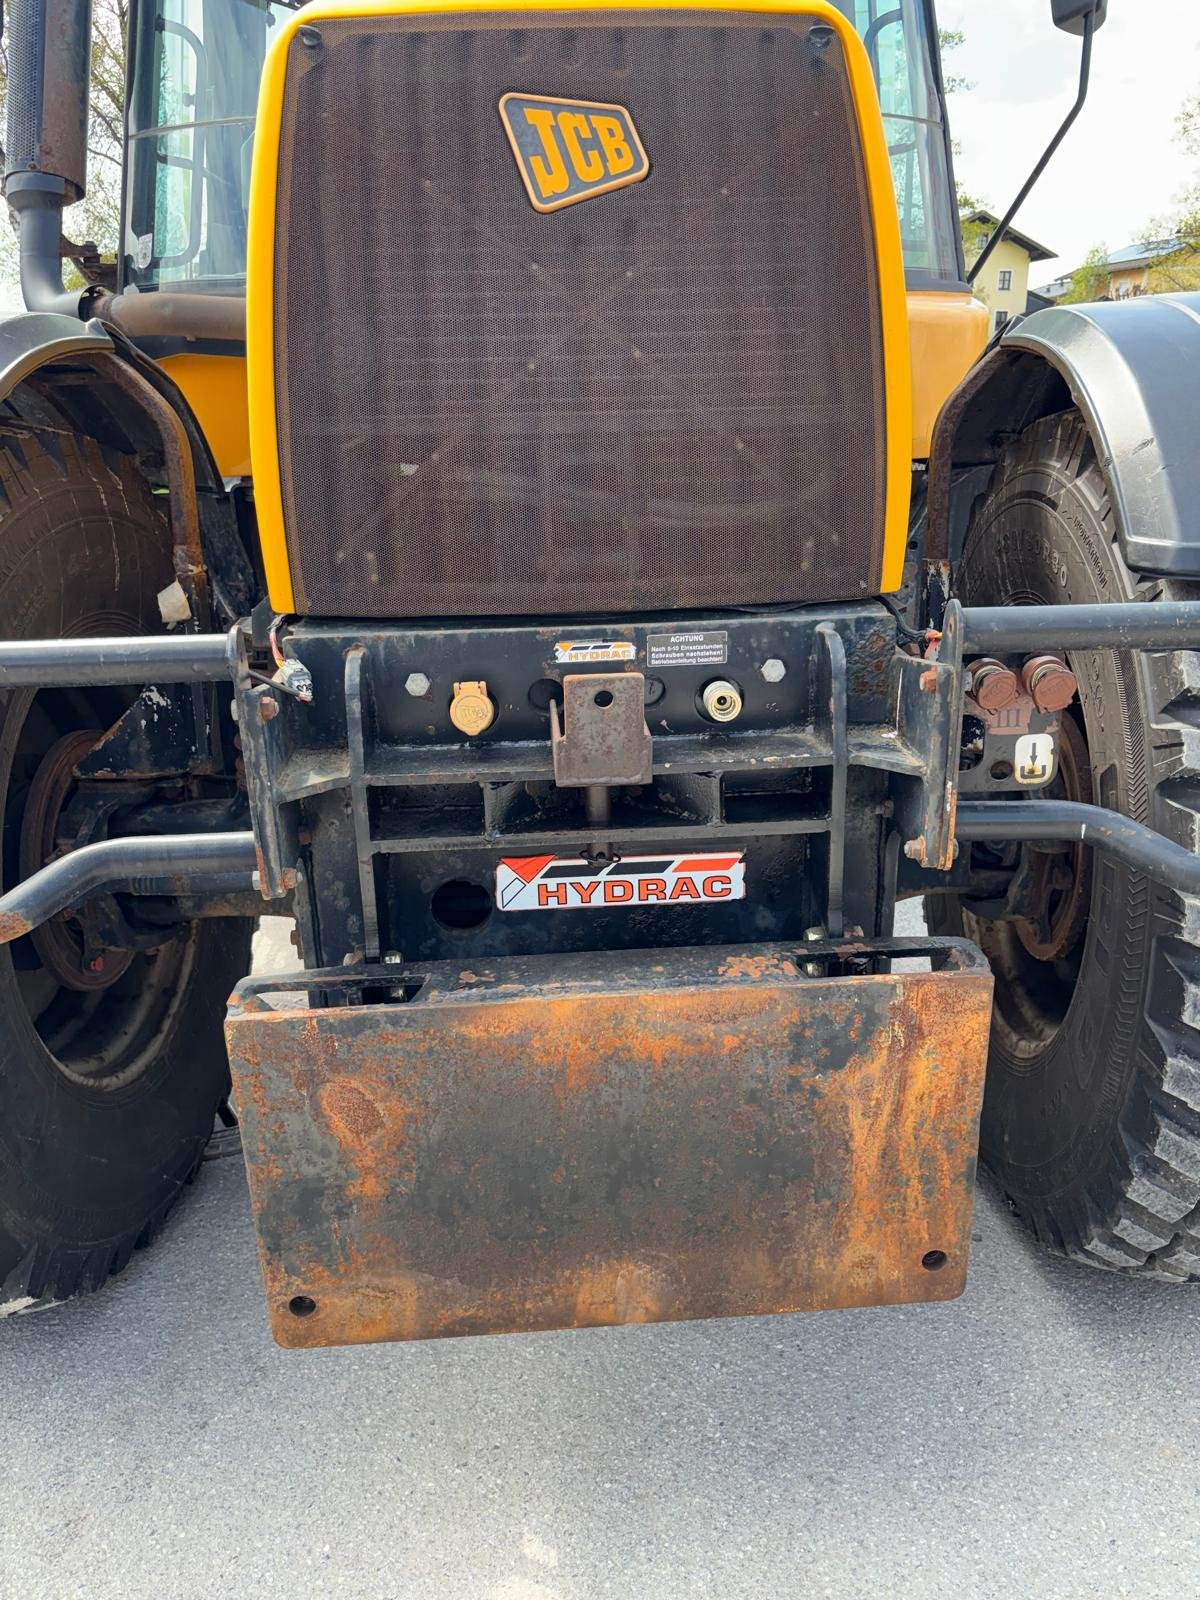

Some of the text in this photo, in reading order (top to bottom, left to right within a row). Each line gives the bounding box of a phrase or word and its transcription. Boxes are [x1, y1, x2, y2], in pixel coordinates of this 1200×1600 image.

[523, 107, 634, 198] JCB
[670, 634, 704, 643] ACHTUNG
[680, 643, 723, 651] Einsatzstunden
[568, 651, 632, 661] HYDRAC
[537, 875, 732, 906] HYDRAC
